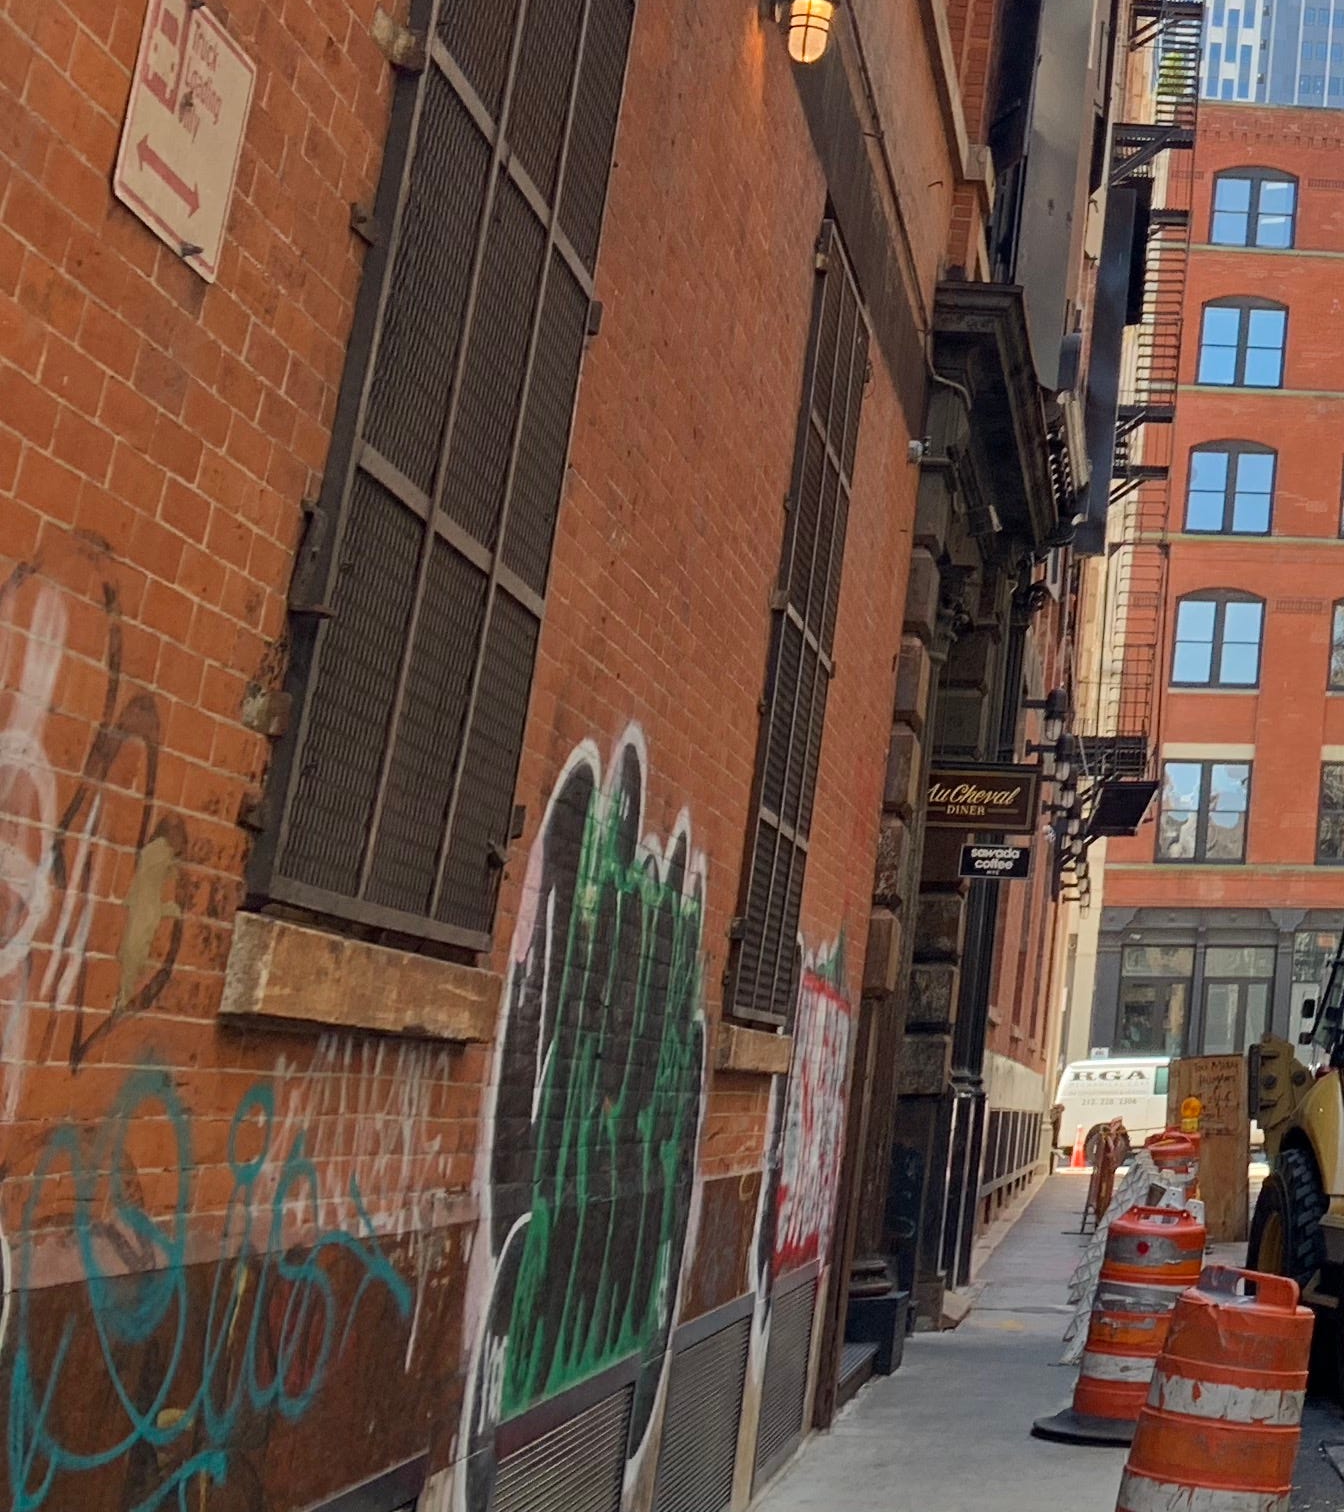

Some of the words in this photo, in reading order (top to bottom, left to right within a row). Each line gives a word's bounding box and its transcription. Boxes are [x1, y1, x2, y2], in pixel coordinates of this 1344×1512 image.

[192, 19, 220, 72] Truck
[950, 783, 1021, 806] Cheval
[946, 804, 987, 817] DINER
[970, 846, 1021, 860] sawada
[974, 857, 1014, 871] coffee
[1068, 1070, 1149, 1081] RGA
